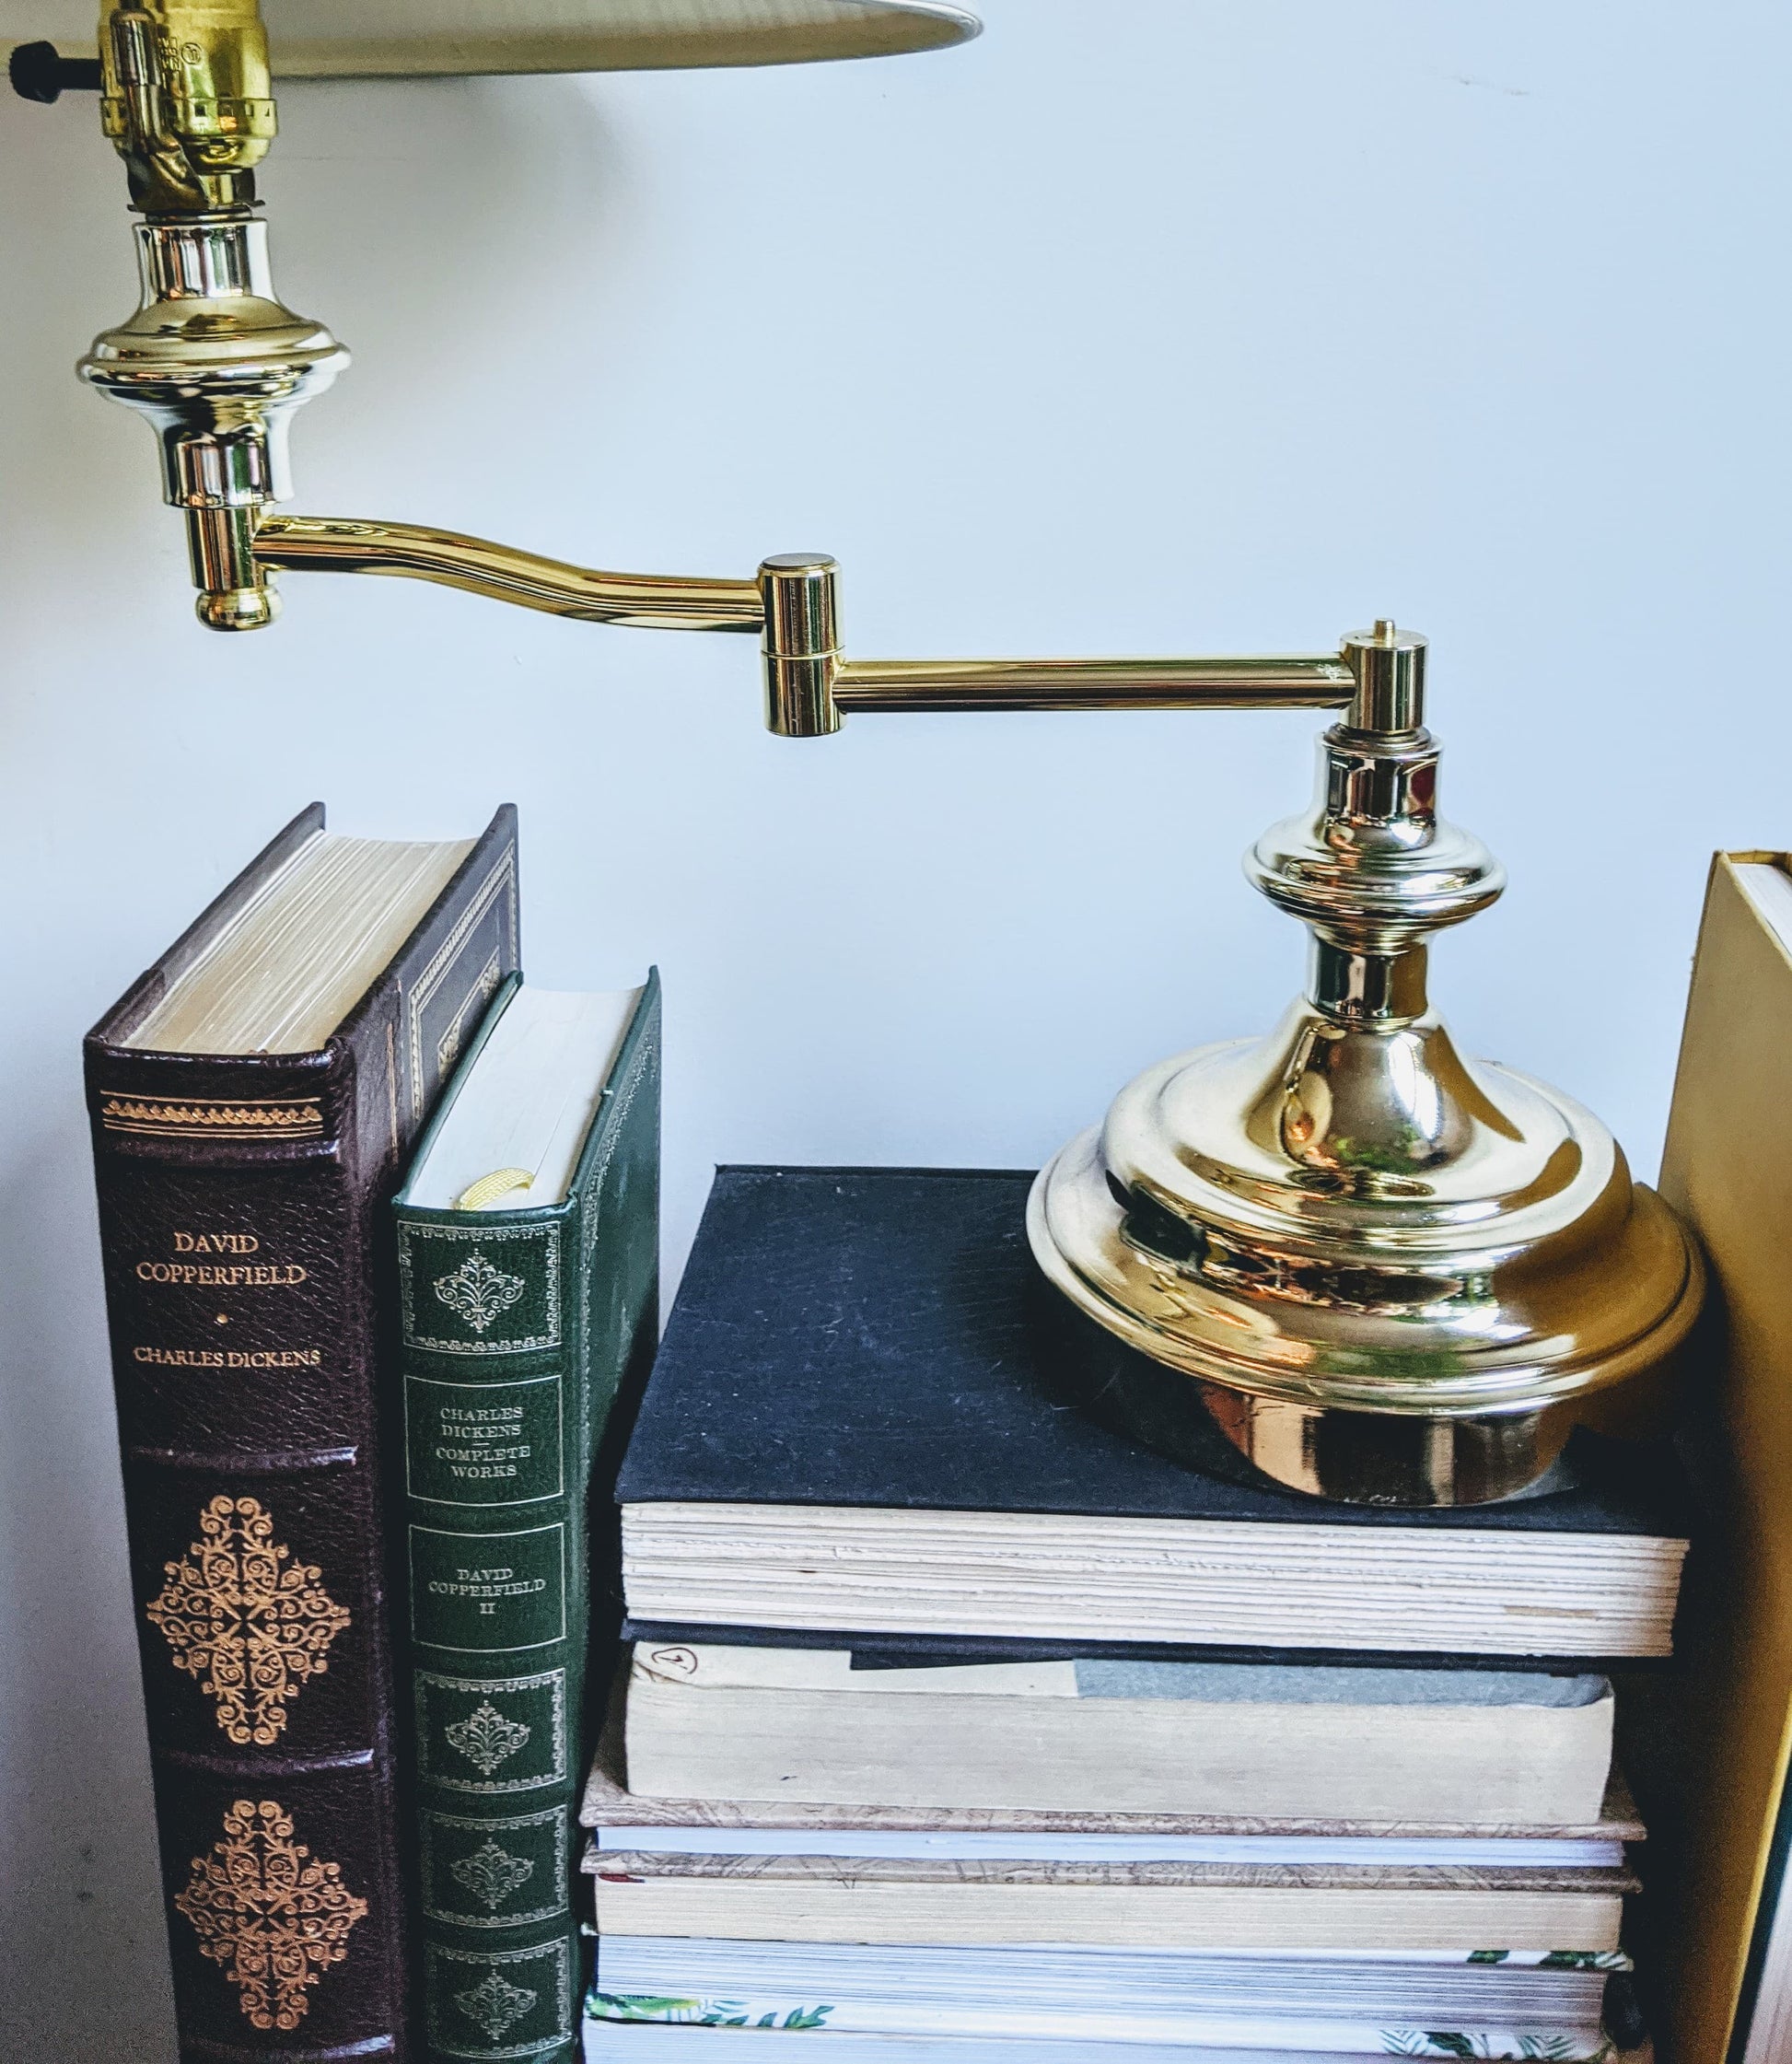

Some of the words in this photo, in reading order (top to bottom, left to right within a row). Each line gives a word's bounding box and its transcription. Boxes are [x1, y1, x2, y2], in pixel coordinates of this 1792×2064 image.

[174, 1231, 260, 1254] DAVID
[136, 1262, 308, 1286] COPPERFIELD
[133, 1347, 225, 1368] CHARLES
[227, 1349, 321, 1368] DICKENS
[440, 1406, 525, 1421] CHARLES
[441, 1424, 522, 1439] DICKENS
[436, 1445, 531, 1462] COMPLETE
[450, 1464, 518, 1478] WORKS
[456, 1568, 514, 1581] DAVID
[427, 1579, 547, 1597] COPPERFIELD
